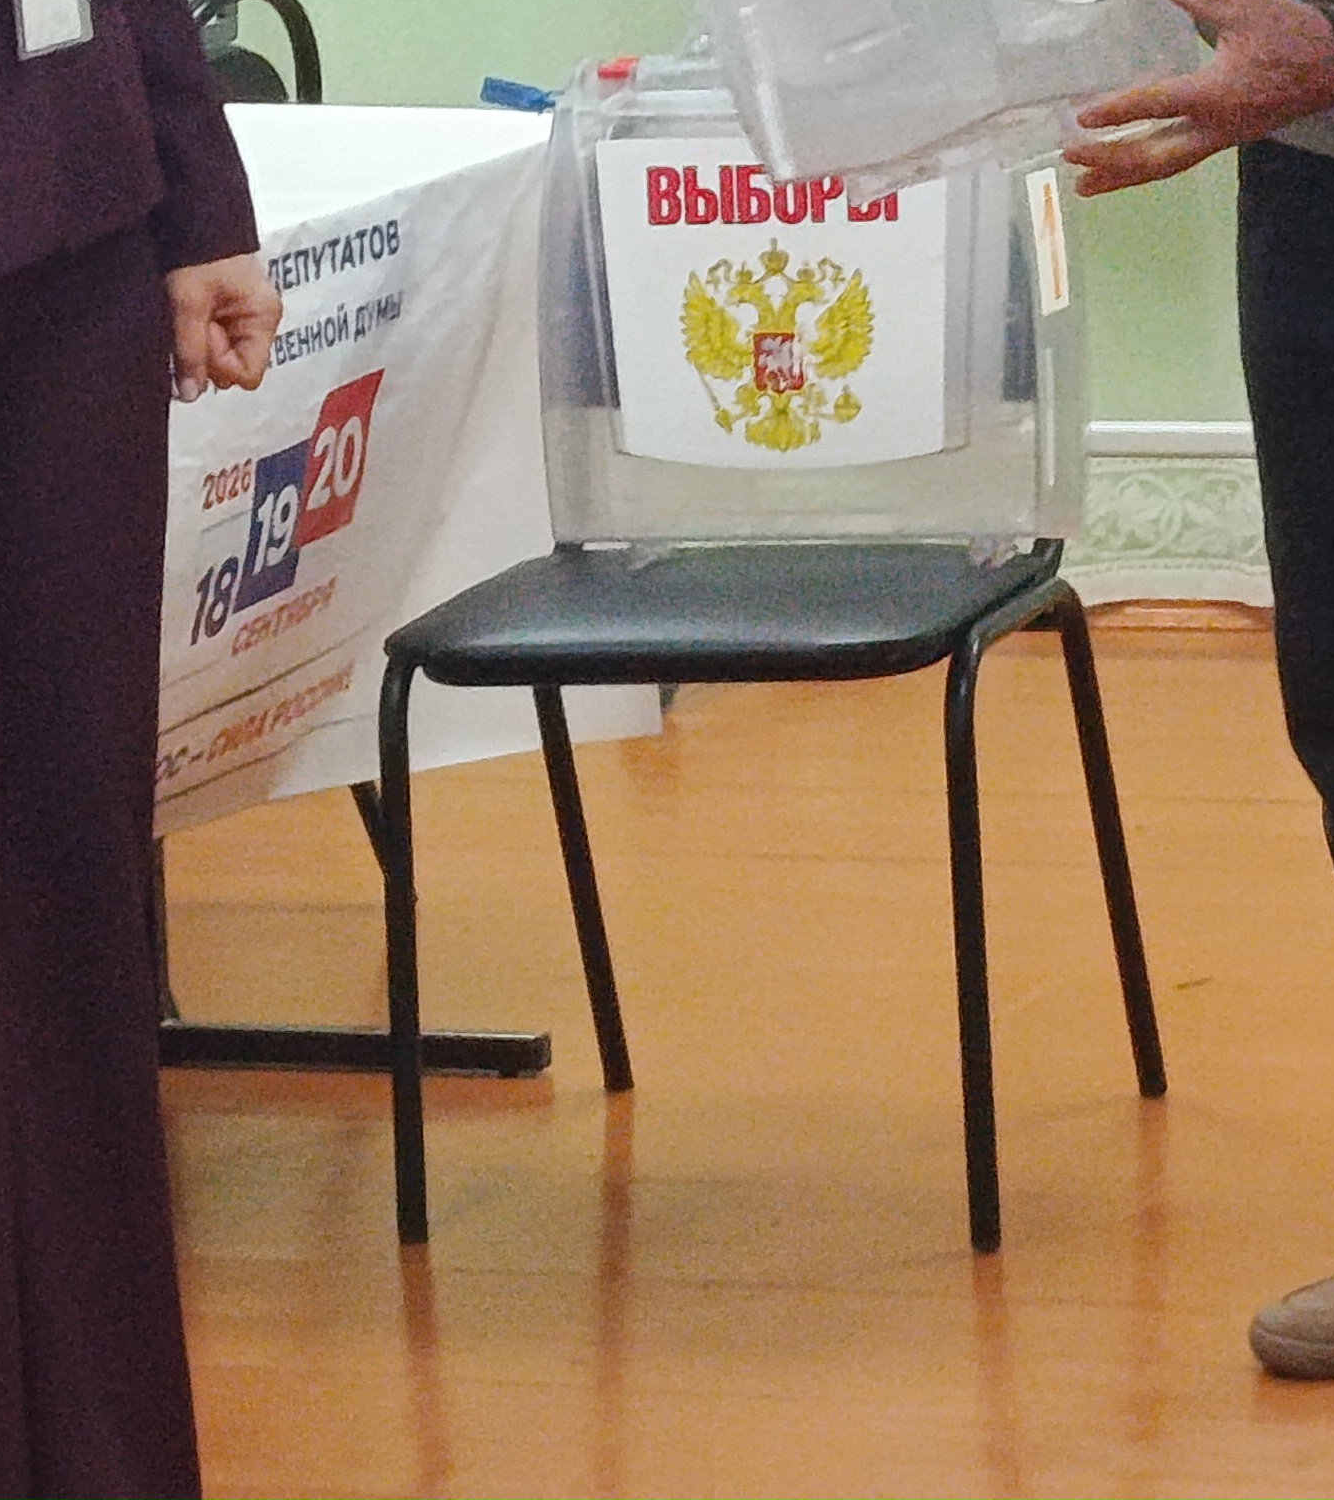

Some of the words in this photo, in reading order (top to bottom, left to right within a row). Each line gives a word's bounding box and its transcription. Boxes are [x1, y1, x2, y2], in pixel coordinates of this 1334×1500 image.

[646, 163, 899, 226] ВЫБОРЫ
[269, 303, 349, 368] ВЕННОЙ
[202, 457, 252, 512] 2026
[190, 556, 239, 646] 18
[252, 483, 299, 576] 19
[307, 416, 363, 511] 20
